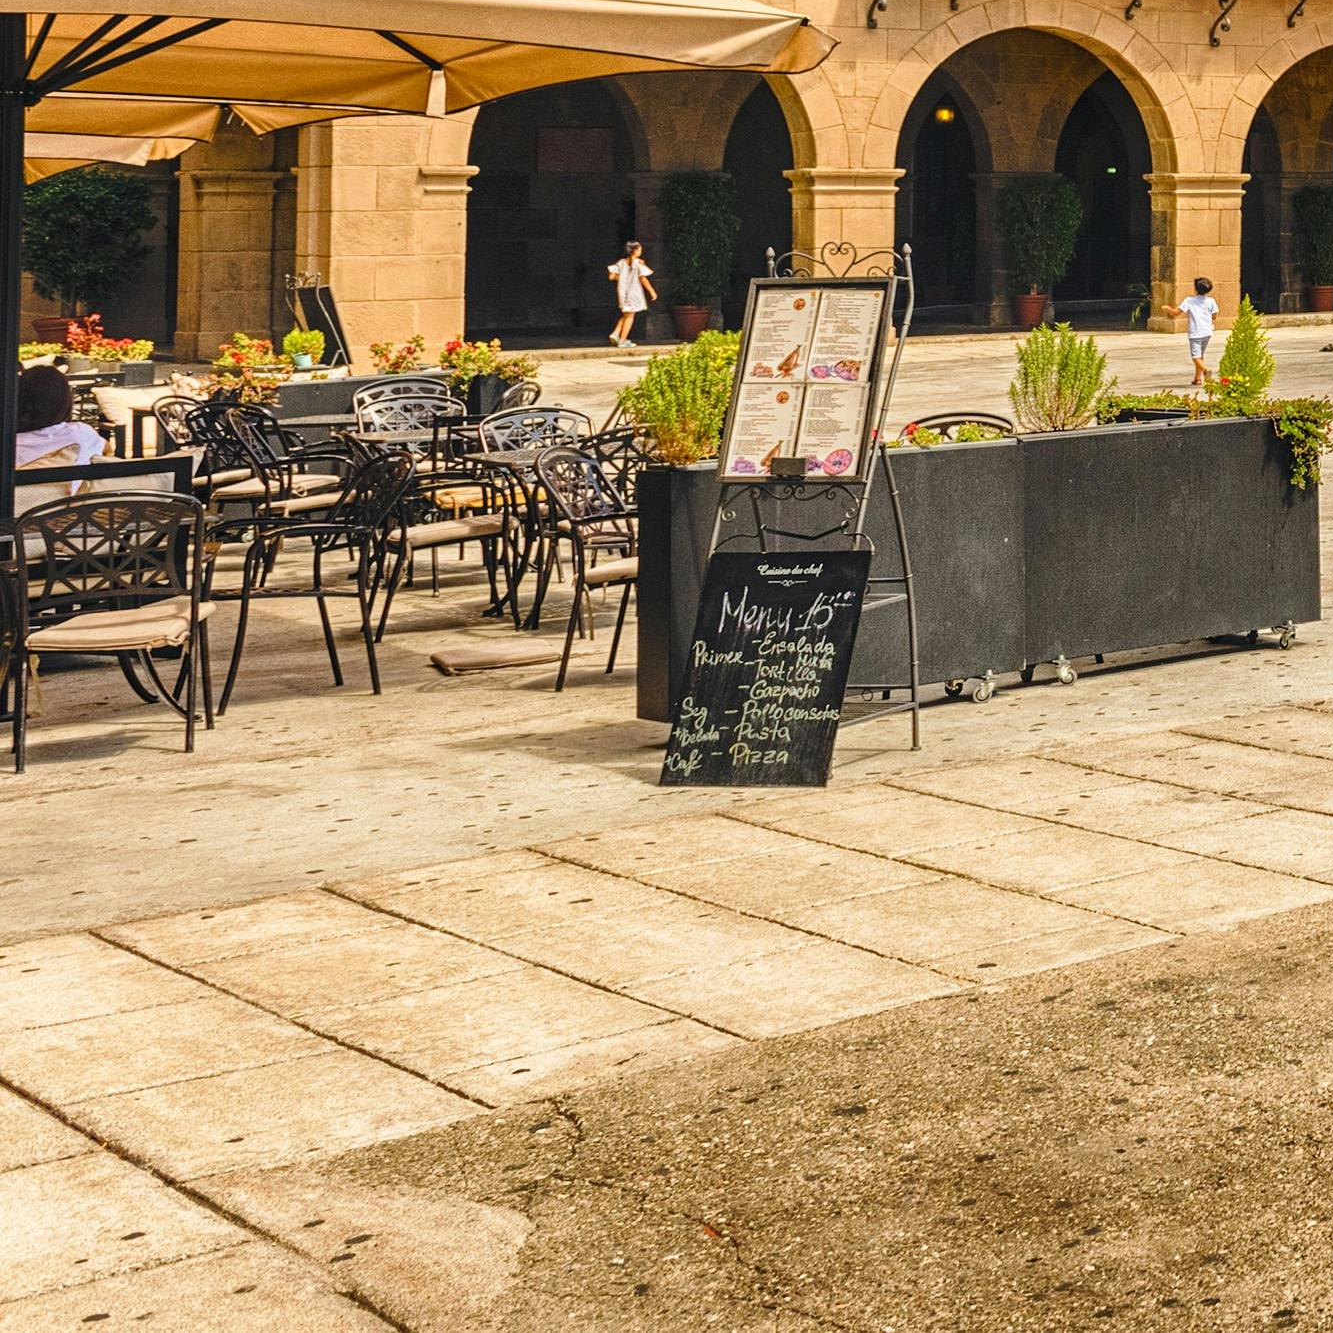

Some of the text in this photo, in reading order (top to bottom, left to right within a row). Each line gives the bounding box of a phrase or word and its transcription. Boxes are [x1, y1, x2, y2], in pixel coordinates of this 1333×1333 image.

[757, 563, 824, 578] Cuisine du chef
[758, 631, 836, 655] Ensalada
[750, 679, 820, 704] Gazpacho
[680, 696, 708, 730] Seg
[733, 720, 791, 742] Pasta
[729, 742, 789, 766] Pizza
